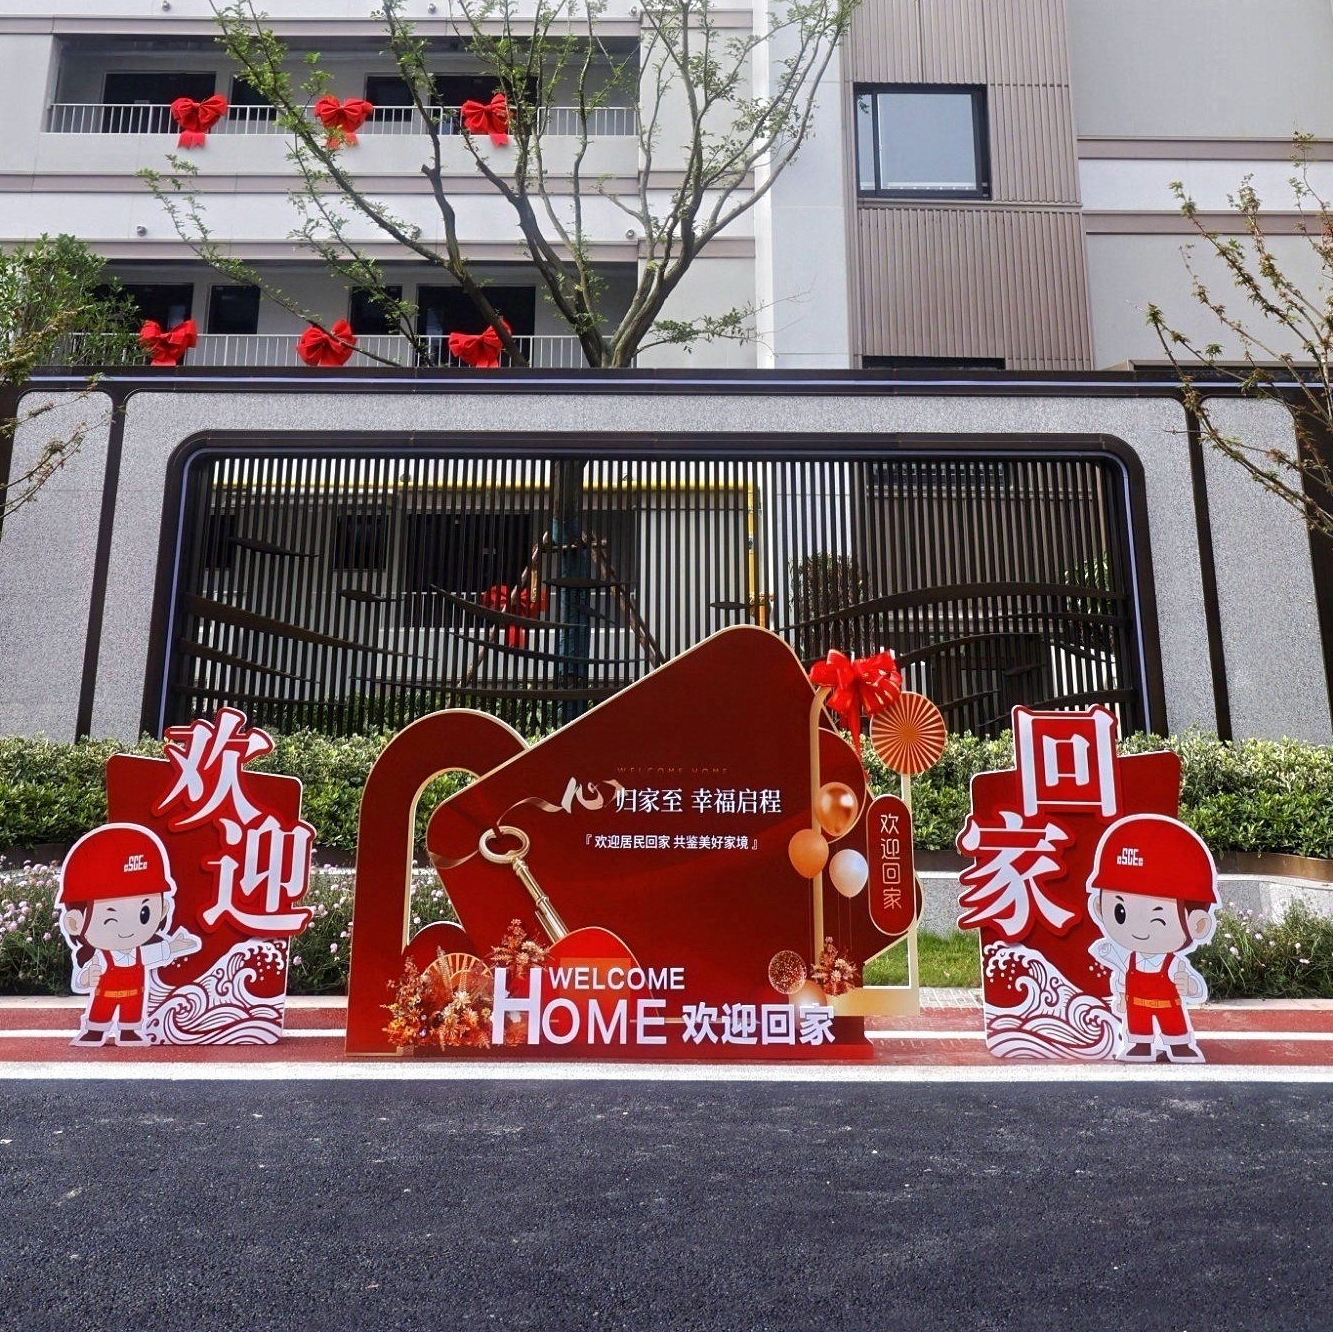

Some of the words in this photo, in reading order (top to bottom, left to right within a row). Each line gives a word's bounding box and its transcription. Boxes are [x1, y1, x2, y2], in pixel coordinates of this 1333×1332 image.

[157, 711, 310, 931] 欢迎
[691, 787, 782, 814] 幸福启程
[962, 709, 1118, 937] 回家
[880, 813, 903, 910] 欢迎回家
[491, 967, 667, 1045] HOME
[549, 967, 685, 990] WELCOME
[682, 1002, 836, 1045] 欢迎回家
